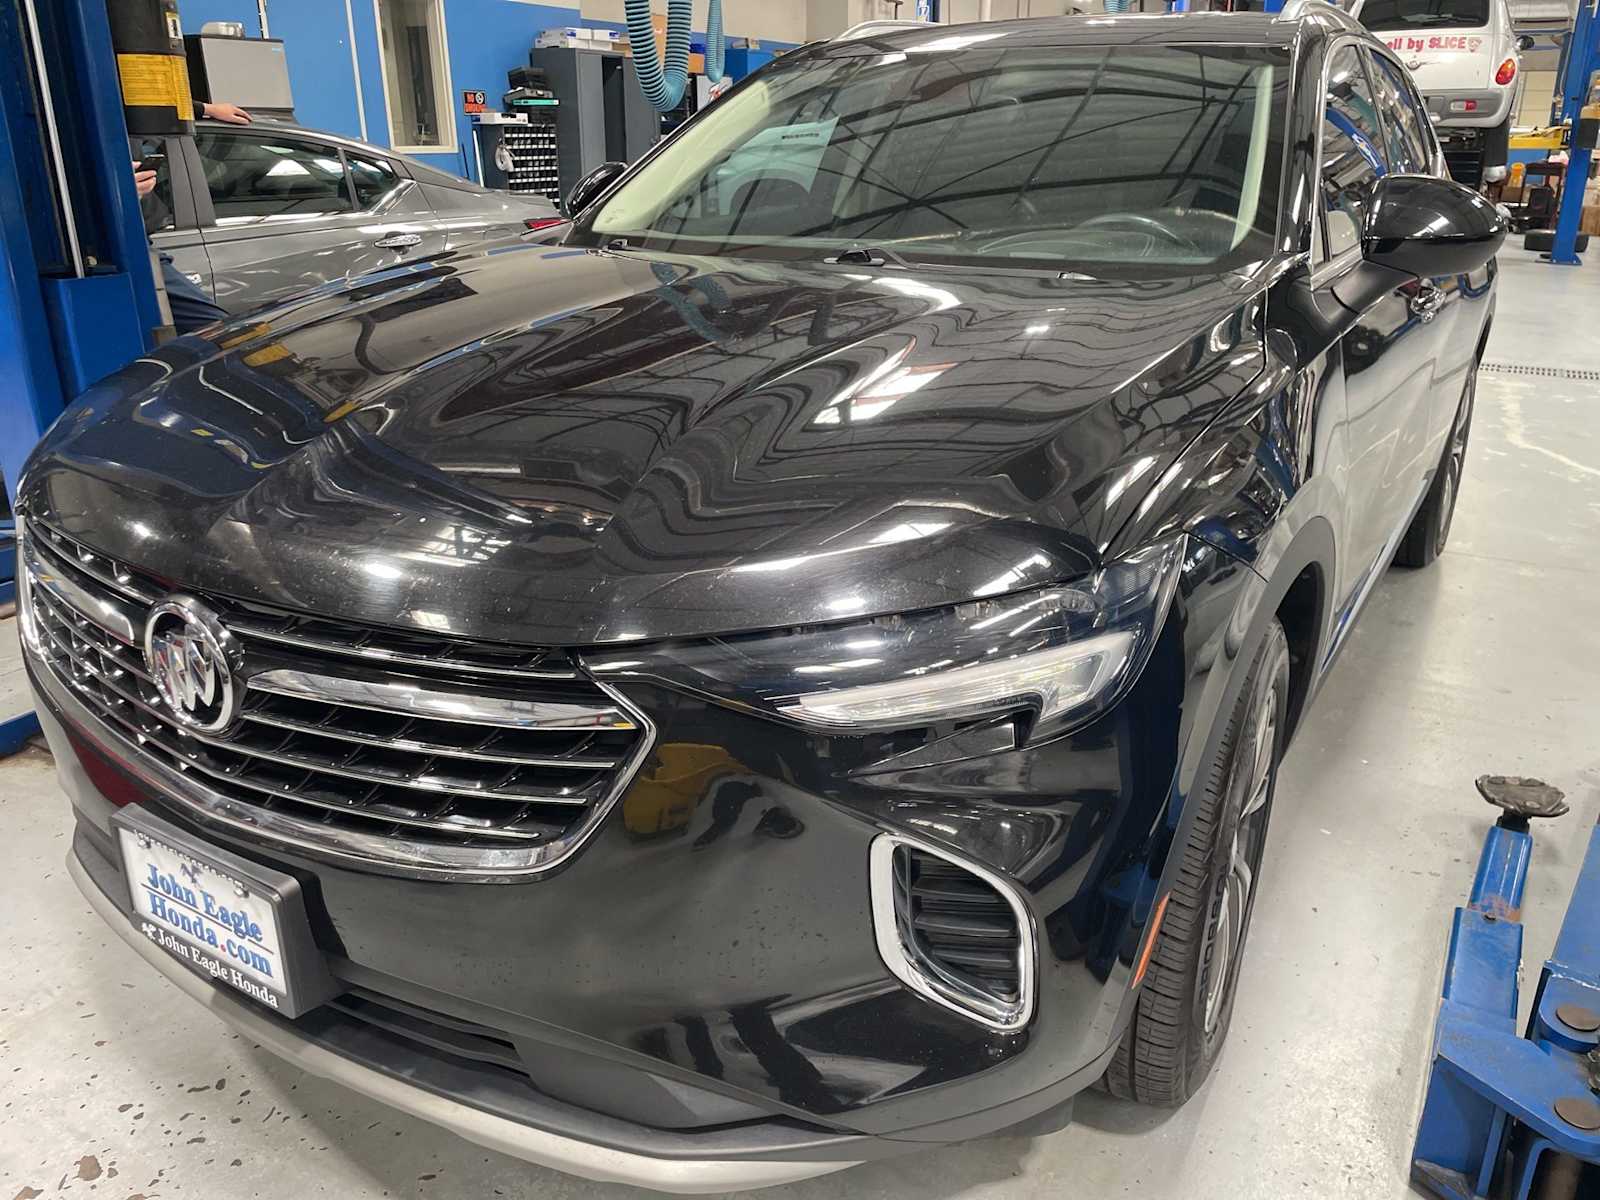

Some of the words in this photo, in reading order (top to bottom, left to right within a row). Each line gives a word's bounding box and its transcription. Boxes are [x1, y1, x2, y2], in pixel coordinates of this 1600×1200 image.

[1407, 37, 1424, 52] by
[147, 863, 197, 907] John
[200, 890, 263, 942] Eagle
[147, 891, 273, 978] Honda.com
[158, 927, 189, 956] John
[192, 948, 229, 980] Eagle
[231, 968, 279, 1008] Honda
